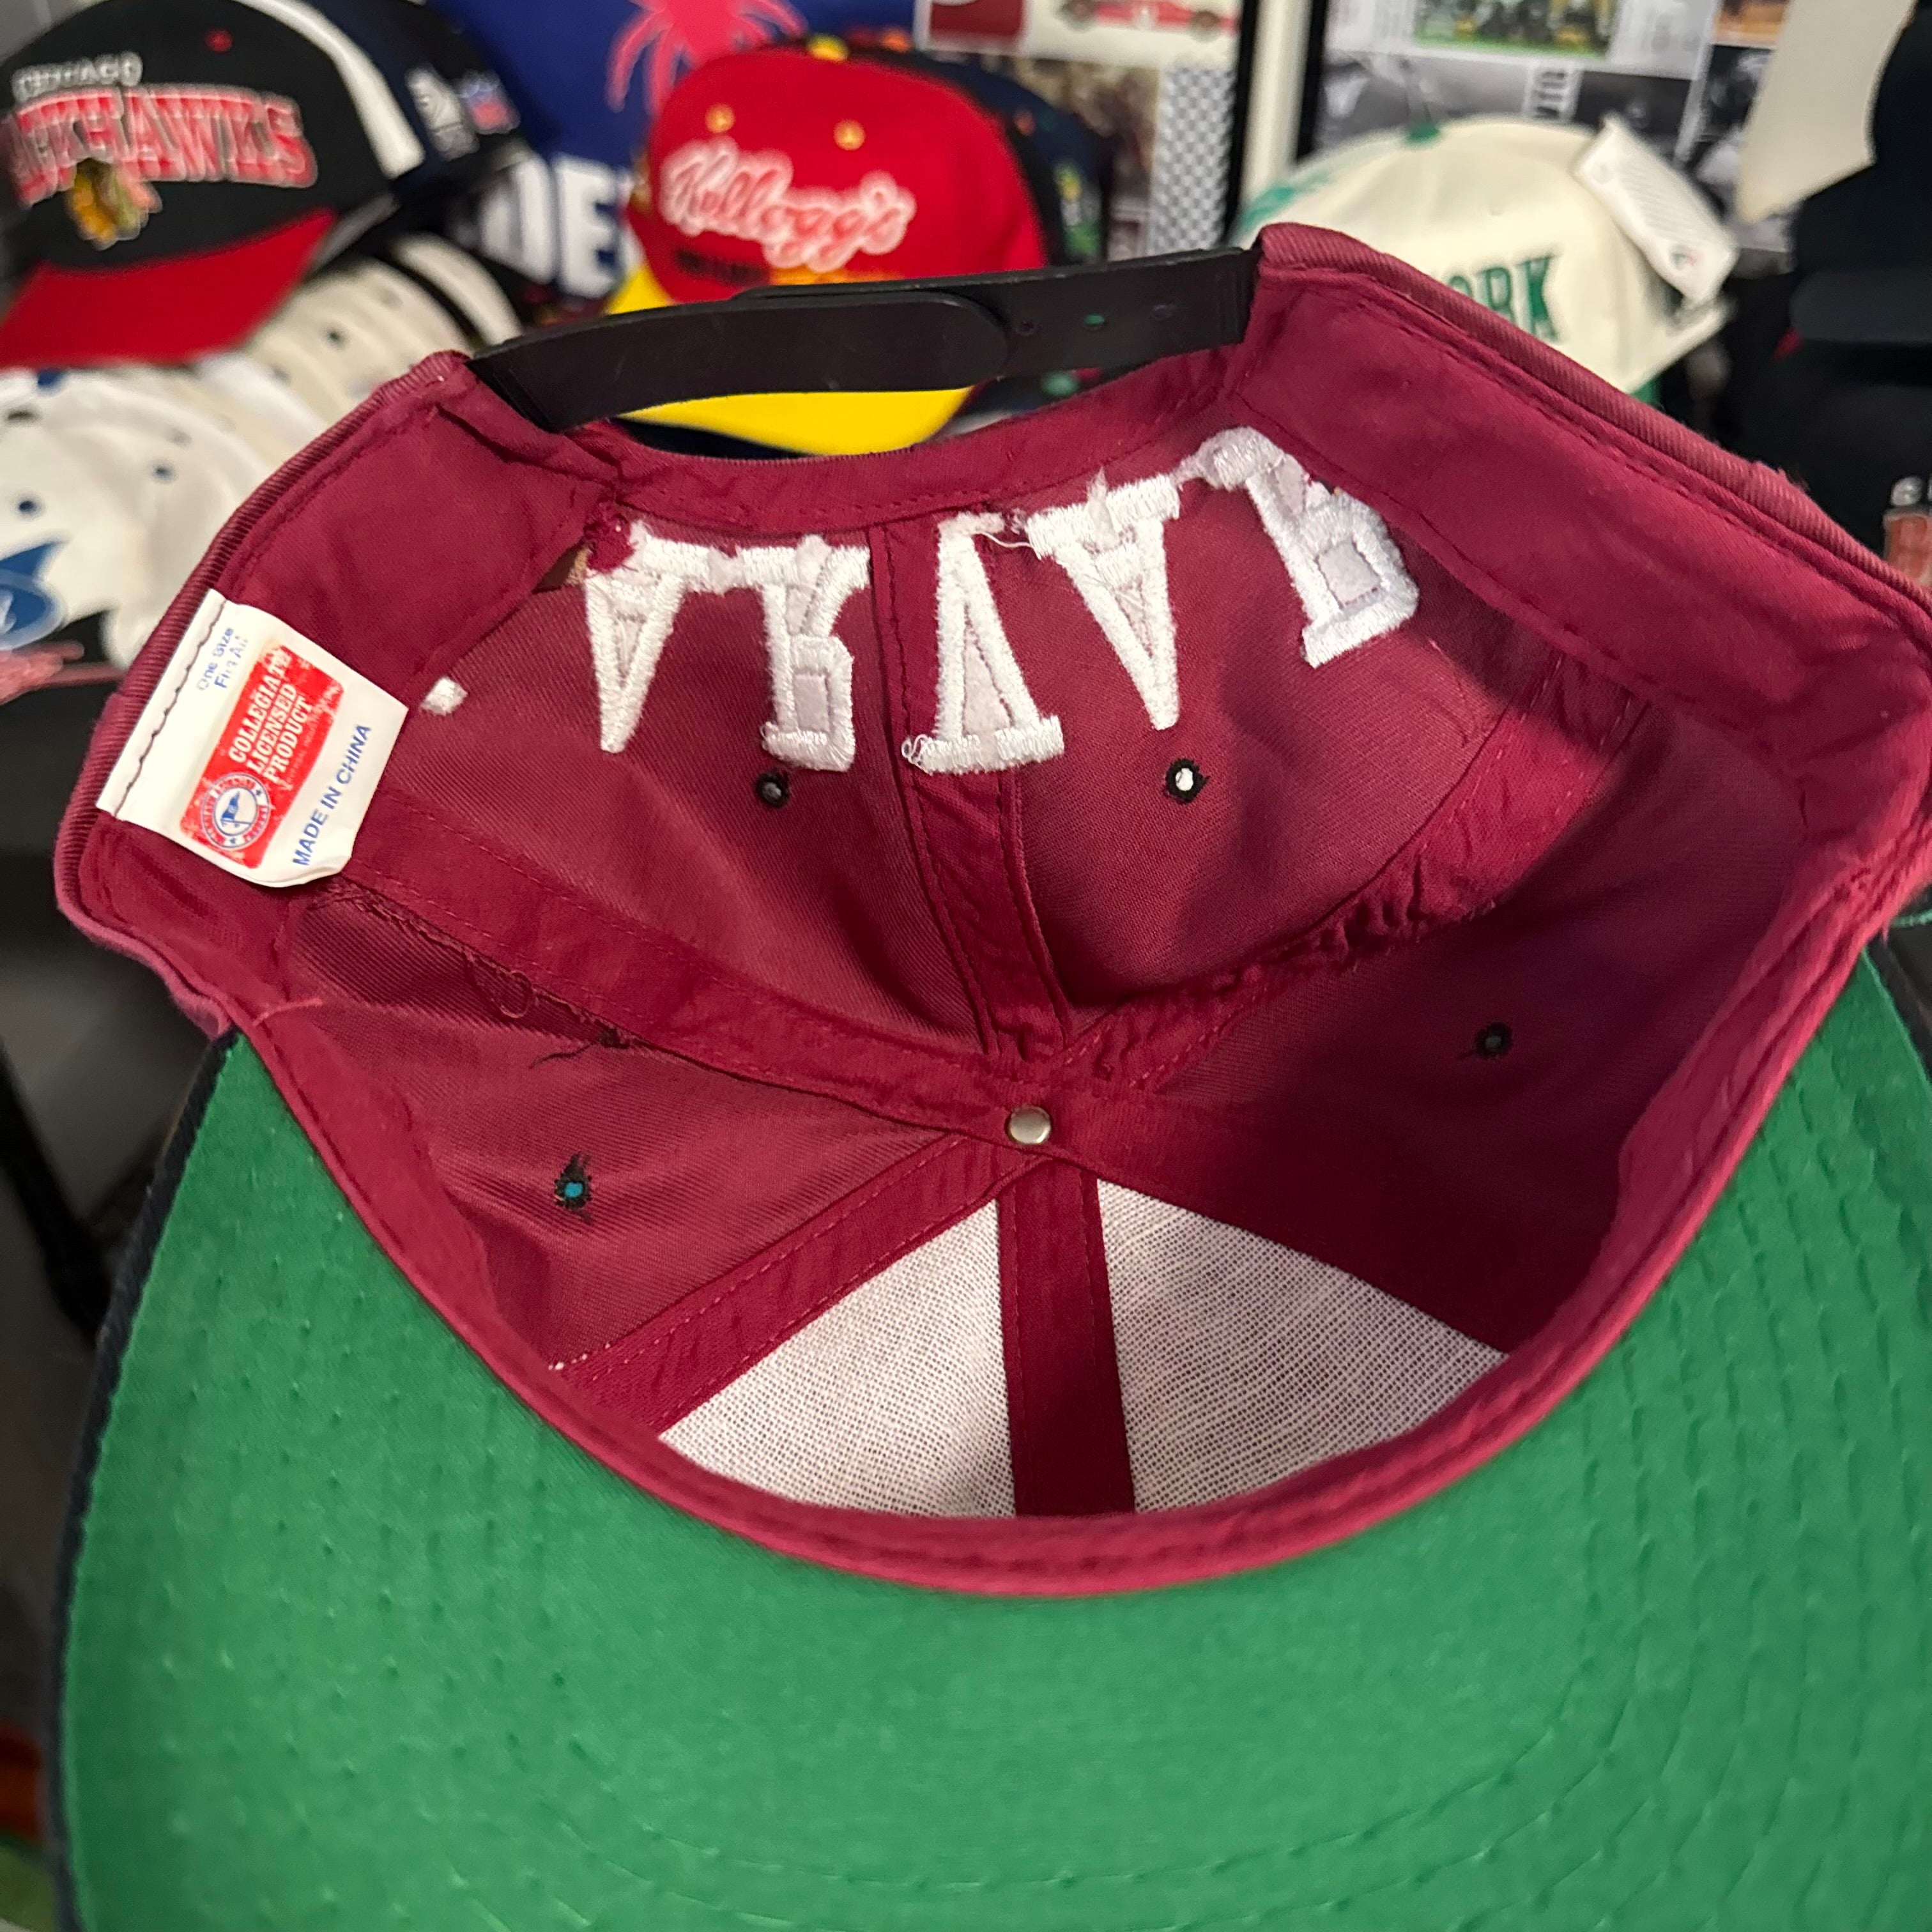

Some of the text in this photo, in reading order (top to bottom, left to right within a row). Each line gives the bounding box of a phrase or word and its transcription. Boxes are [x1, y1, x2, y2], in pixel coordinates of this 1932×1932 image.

[228, 649, 292, 763] COLLEGIATE
[246, 683, 297, 774] LICENSED
[263, 694, 312, 783] PRODUCT
[292, 724, 372, 866] MADE IN CHINA
